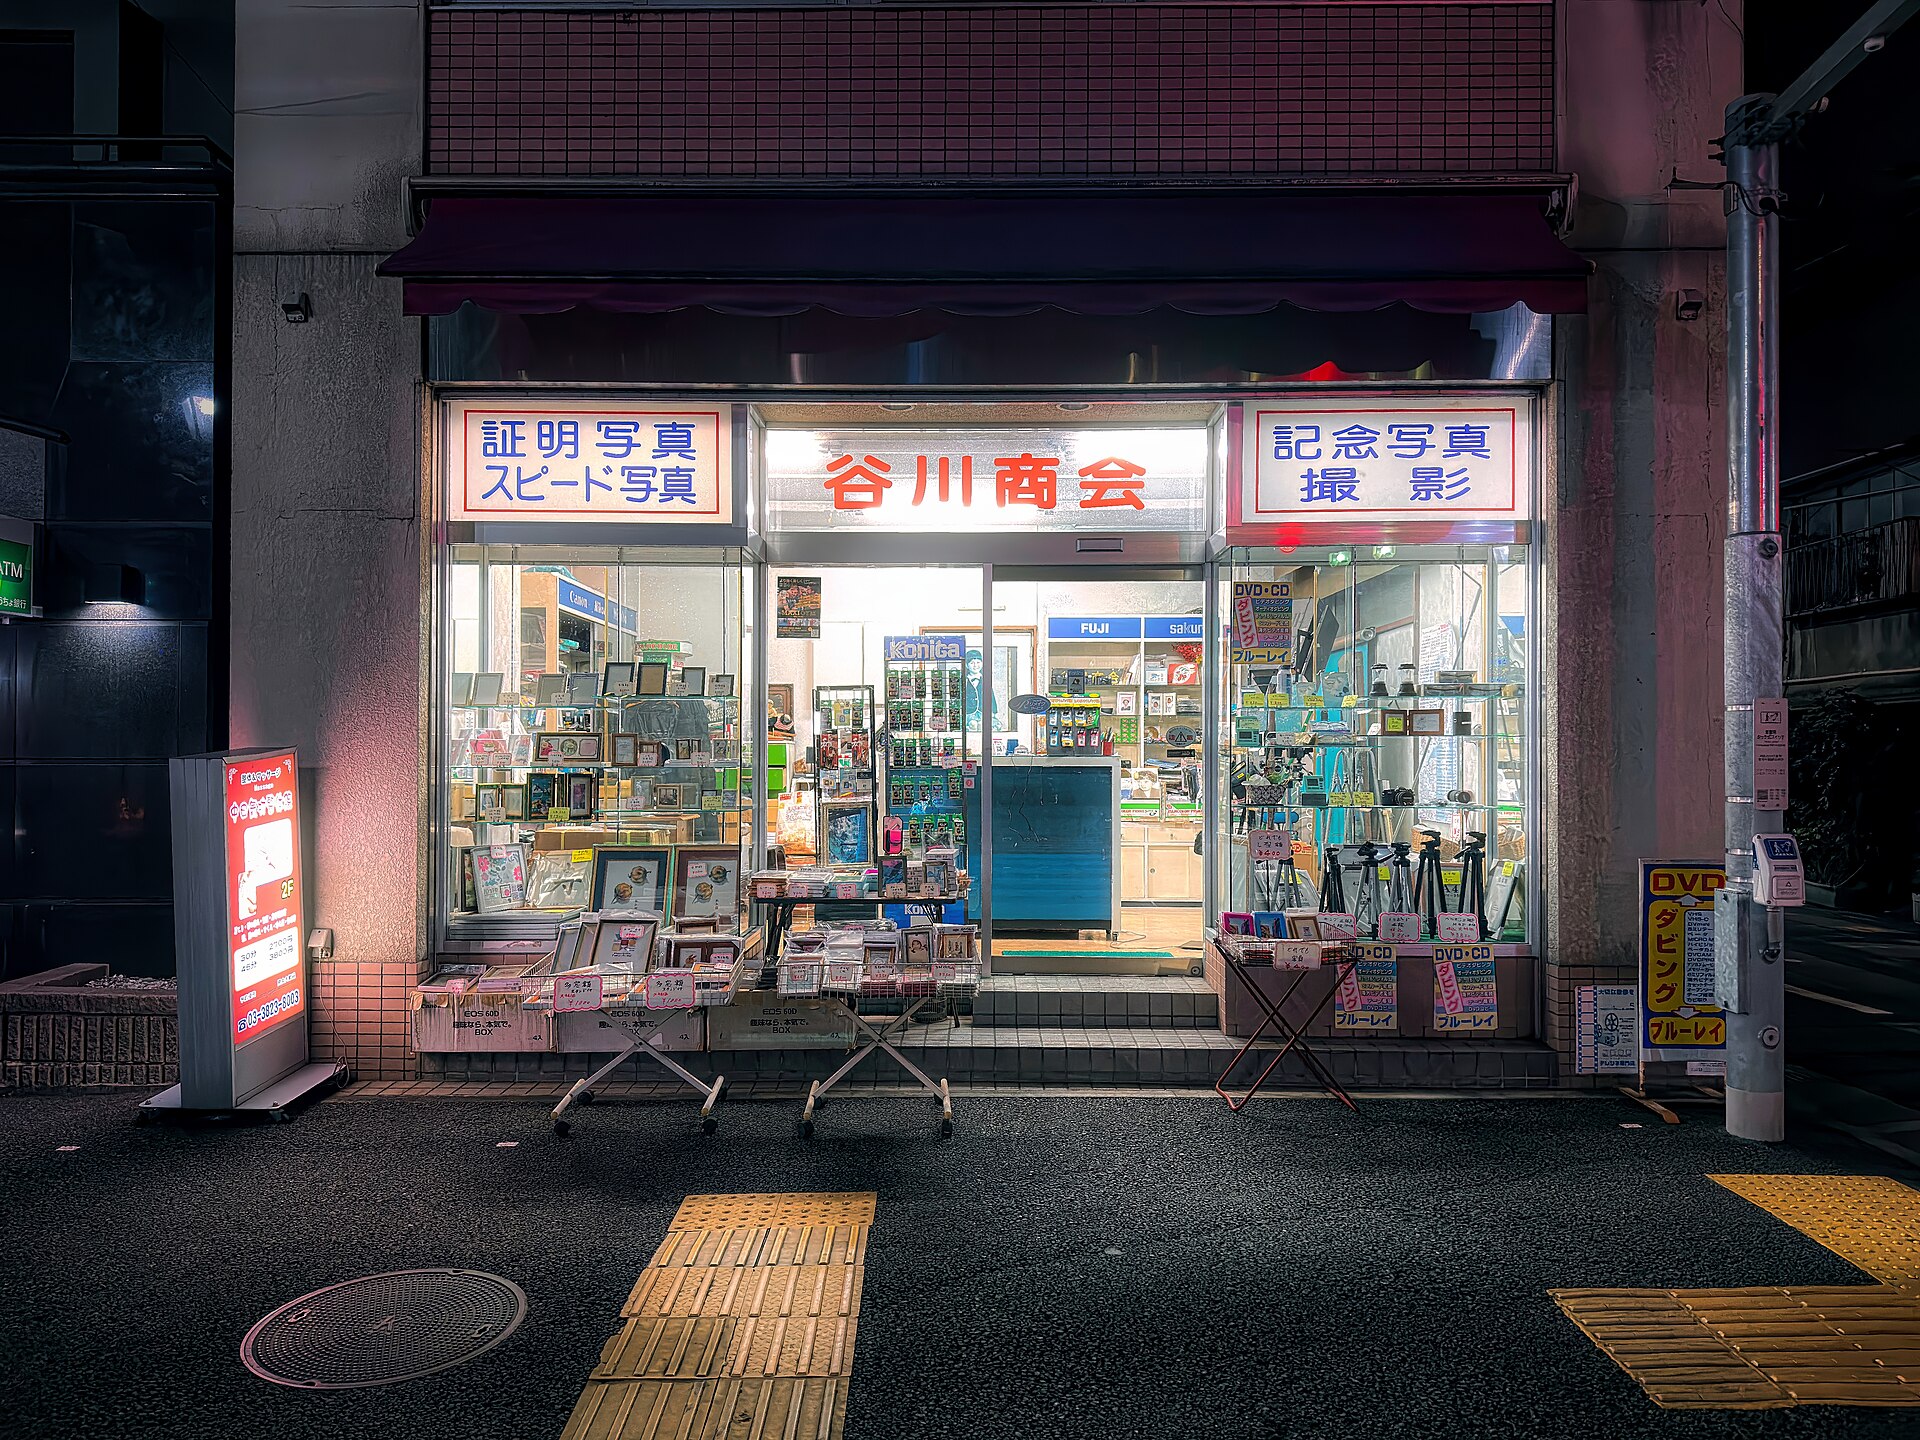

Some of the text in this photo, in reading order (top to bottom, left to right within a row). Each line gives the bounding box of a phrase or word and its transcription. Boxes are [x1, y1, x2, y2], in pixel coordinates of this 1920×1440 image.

[481, 420, 697, 461] 証明写真
[1272, 423, 1491, 460] 記念写真
[481, 464, 697, 505] スピード写真
[823, 452, 1147, 511] 谷川商会
[1080, 622, 1110, 634] FUJI
[1237, 598, 1257, 647] ダビング
[1233, 650, 1289, 663] ブルーレイ
[281, 877, 294, 899] 2F
[1652, 873, 1726, 892] DVD
[1349, 946, 1393, 959] D・CD
[1655, 908, 1679, 1004] ダビング
[1438, 962, 1459, 1012] ダビング
[247, 989, 300, 1026] 03-3823-8003
[463, 1010, 499, 1018] EOS 60D
[610, 1010, 646, 1018] EOS 60D
[783, 1008, 798, 1016] 60D
[1336, 1013, 1393, 1026] ブルーレイ
[1438, 1014, 1494, 1029] ブルーレイ
[1650, 1020, 1723, 1042] ブルーレイ
